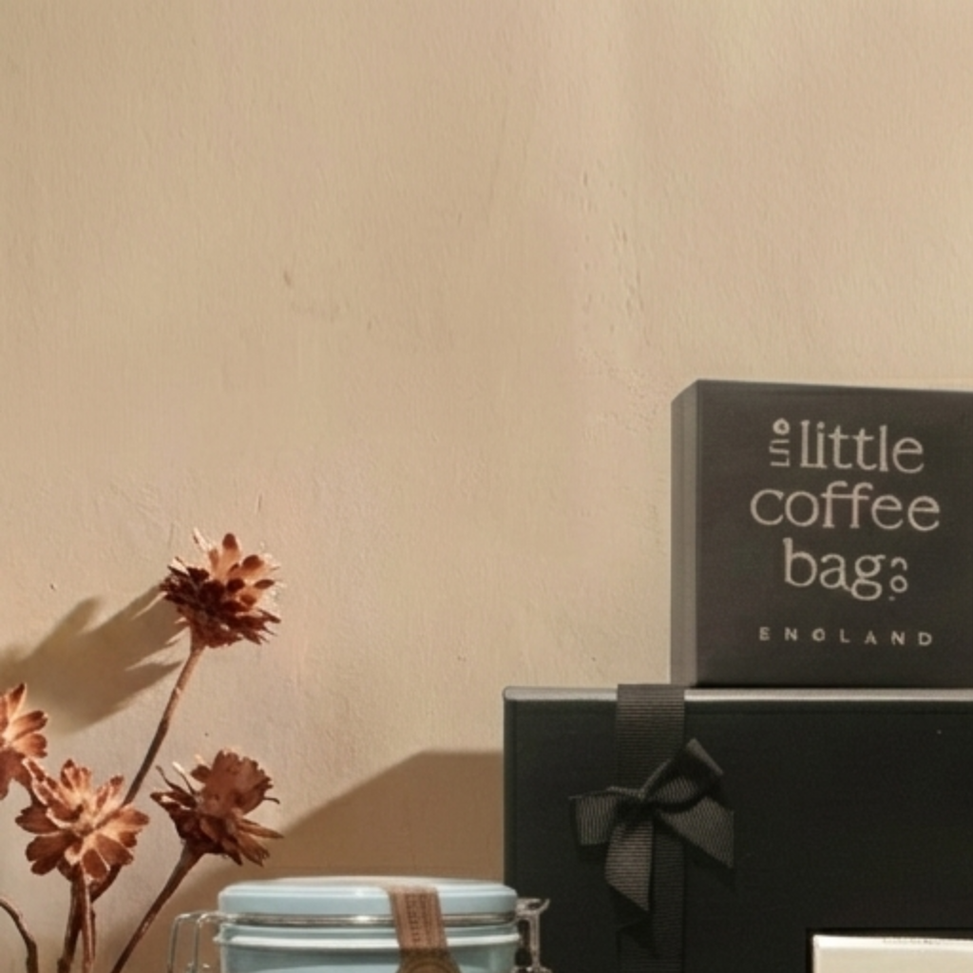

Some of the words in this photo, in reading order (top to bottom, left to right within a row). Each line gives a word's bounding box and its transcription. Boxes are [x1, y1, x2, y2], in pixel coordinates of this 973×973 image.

[800, 419, 924, 474] little
[750, 480, 940, 532] coffee
[783, 537, 886, 601] bag
